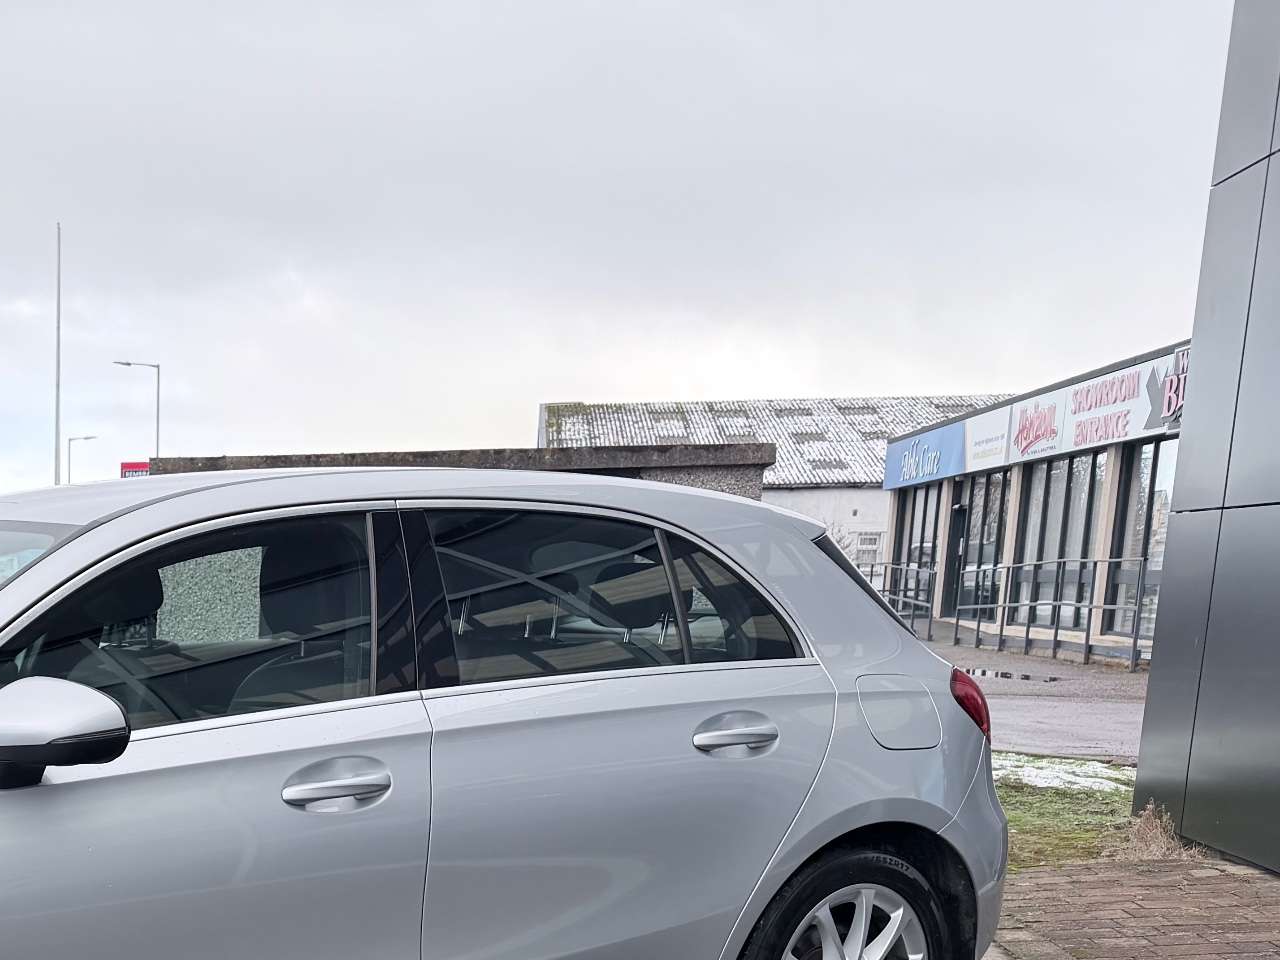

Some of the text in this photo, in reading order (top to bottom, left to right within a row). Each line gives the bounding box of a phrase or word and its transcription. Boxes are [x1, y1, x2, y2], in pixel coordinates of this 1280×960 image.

[1071, 369, 1140, 415] SHOWROOM
[1073, 409, 1130, 447] ENTRANCE
[920, 445, 941, 478] Care
